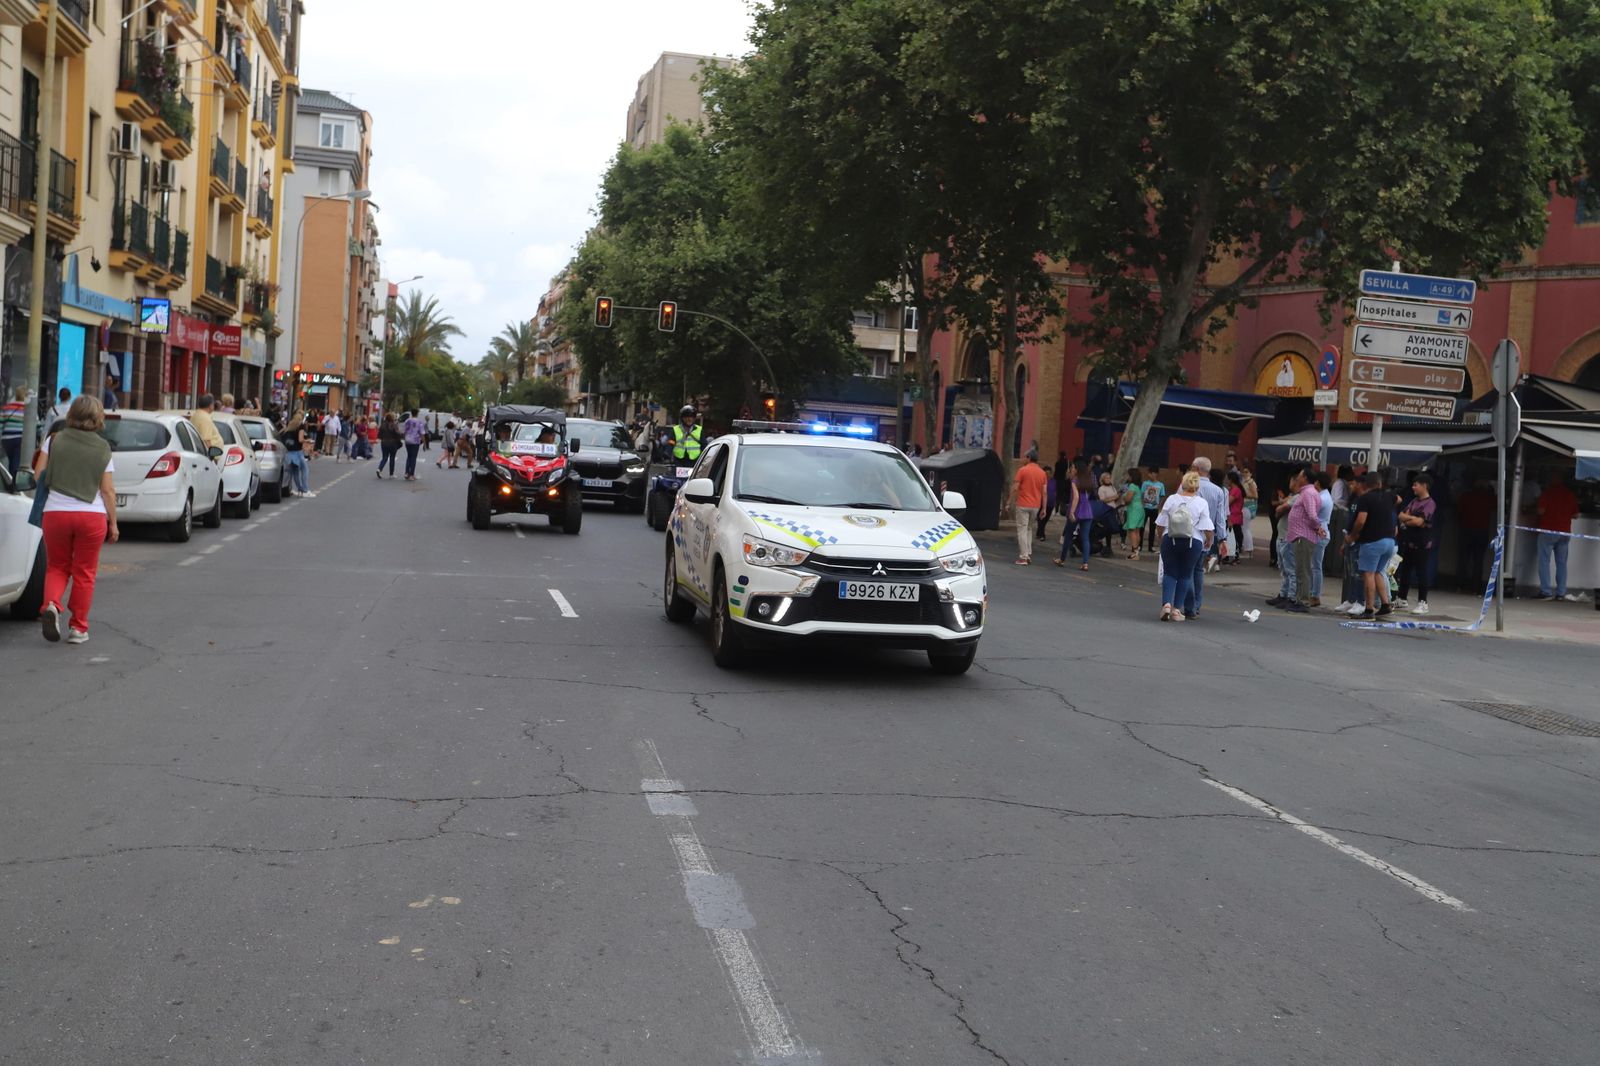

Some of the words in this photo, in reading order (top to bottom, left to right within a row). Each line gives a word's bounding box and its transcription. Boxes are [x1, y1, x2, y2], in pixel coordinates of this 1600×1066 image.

[1365, 276, 1409, 291] SEVILLA
[1362, 304, 1417, 319] hospitales
[1407, 335, 1464, 350] AYAMONTE
[1404, 346, 1463, 361] PORTUGAL
[1267, 386, 1303, 397] CARRETA
[1385, 402, 1419, 414] Marismas
[1420, 406, 1431, 415] del
[1432, 407, 1452, 417] Odiel
[1404, 397, 1427, 408] paraje
[1427, 400, 1453, 410] natural
[1287, 446, 1323, 463] KIOSC
[848, 583, 885, 599] 9926
[889, 584, 916, 600] KZX
